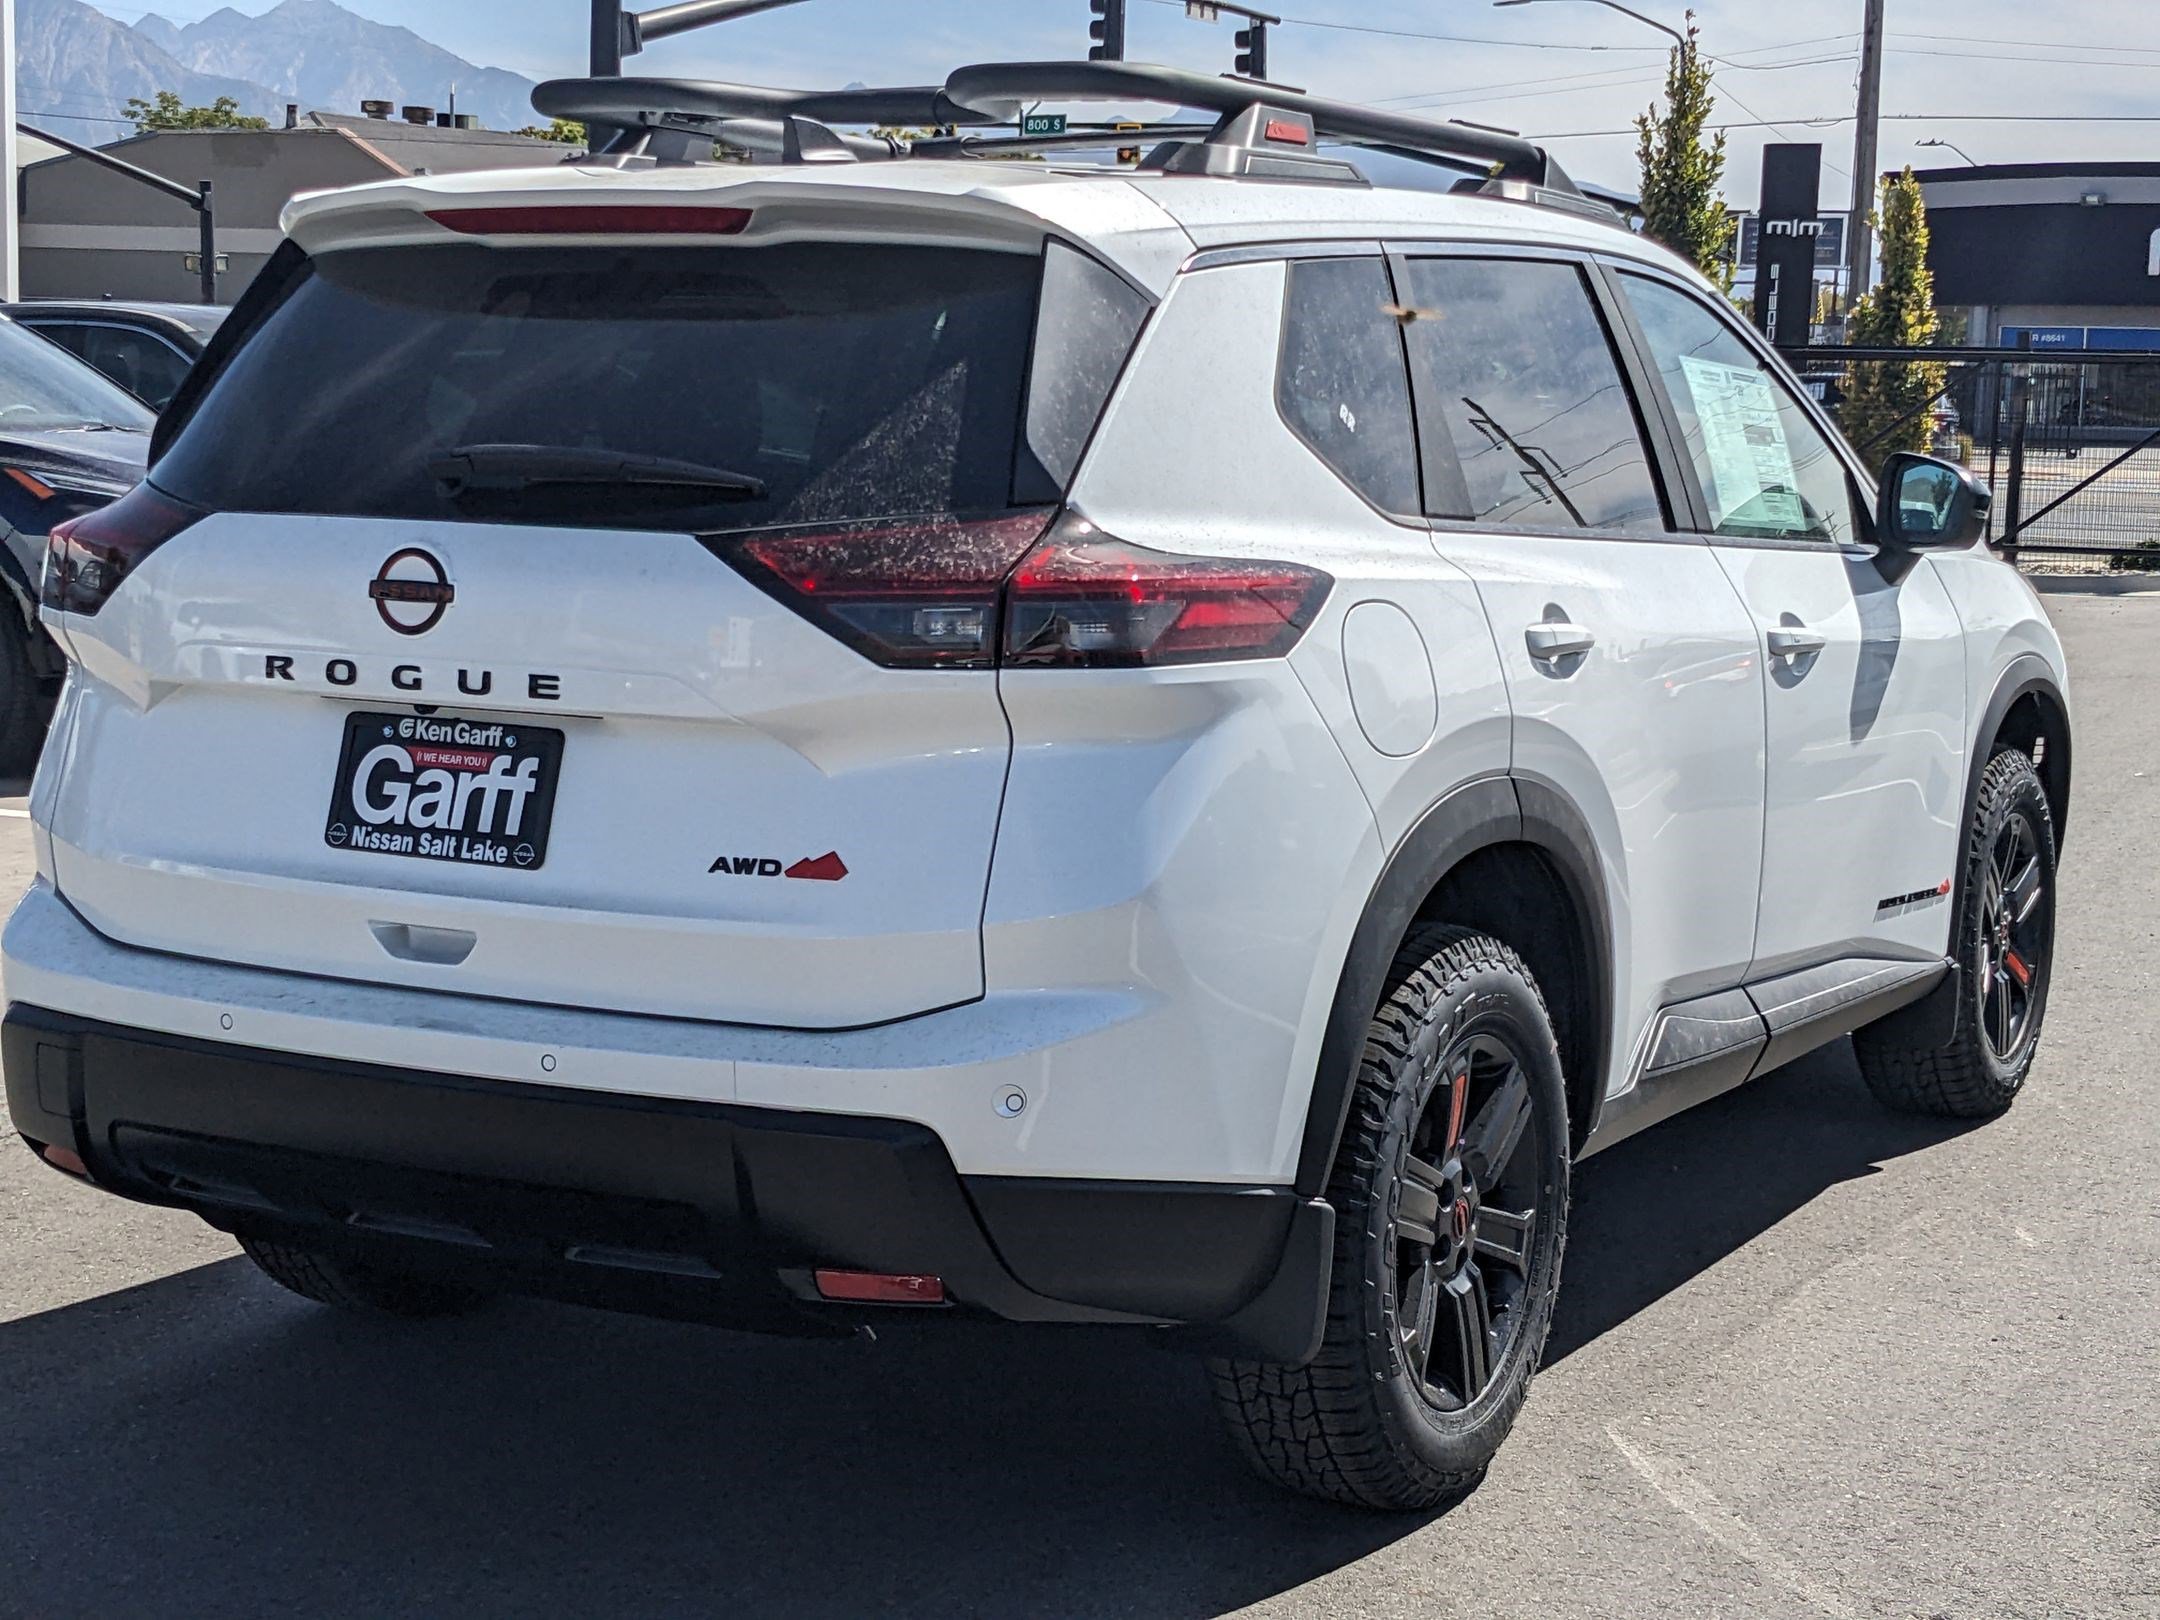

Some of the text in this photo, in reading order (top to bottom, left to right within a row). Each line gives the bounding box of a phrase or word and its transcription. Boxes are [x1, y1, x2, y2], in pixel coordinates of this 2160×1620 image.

[1027, 119, 1060, 131] 800 S
[1766, 263, 1780, 344] ODELS
[265, 655, 561, 700] ROGUE
[415, 719, 503, 747] Ken Garff
[423, 752, 481, 766] WE HEAR YOU
[352, 744, 539, 836] Garff
[351, 825, 508, 863] Nissan Salt Lake
[708, 856, 782, 876] AWD
